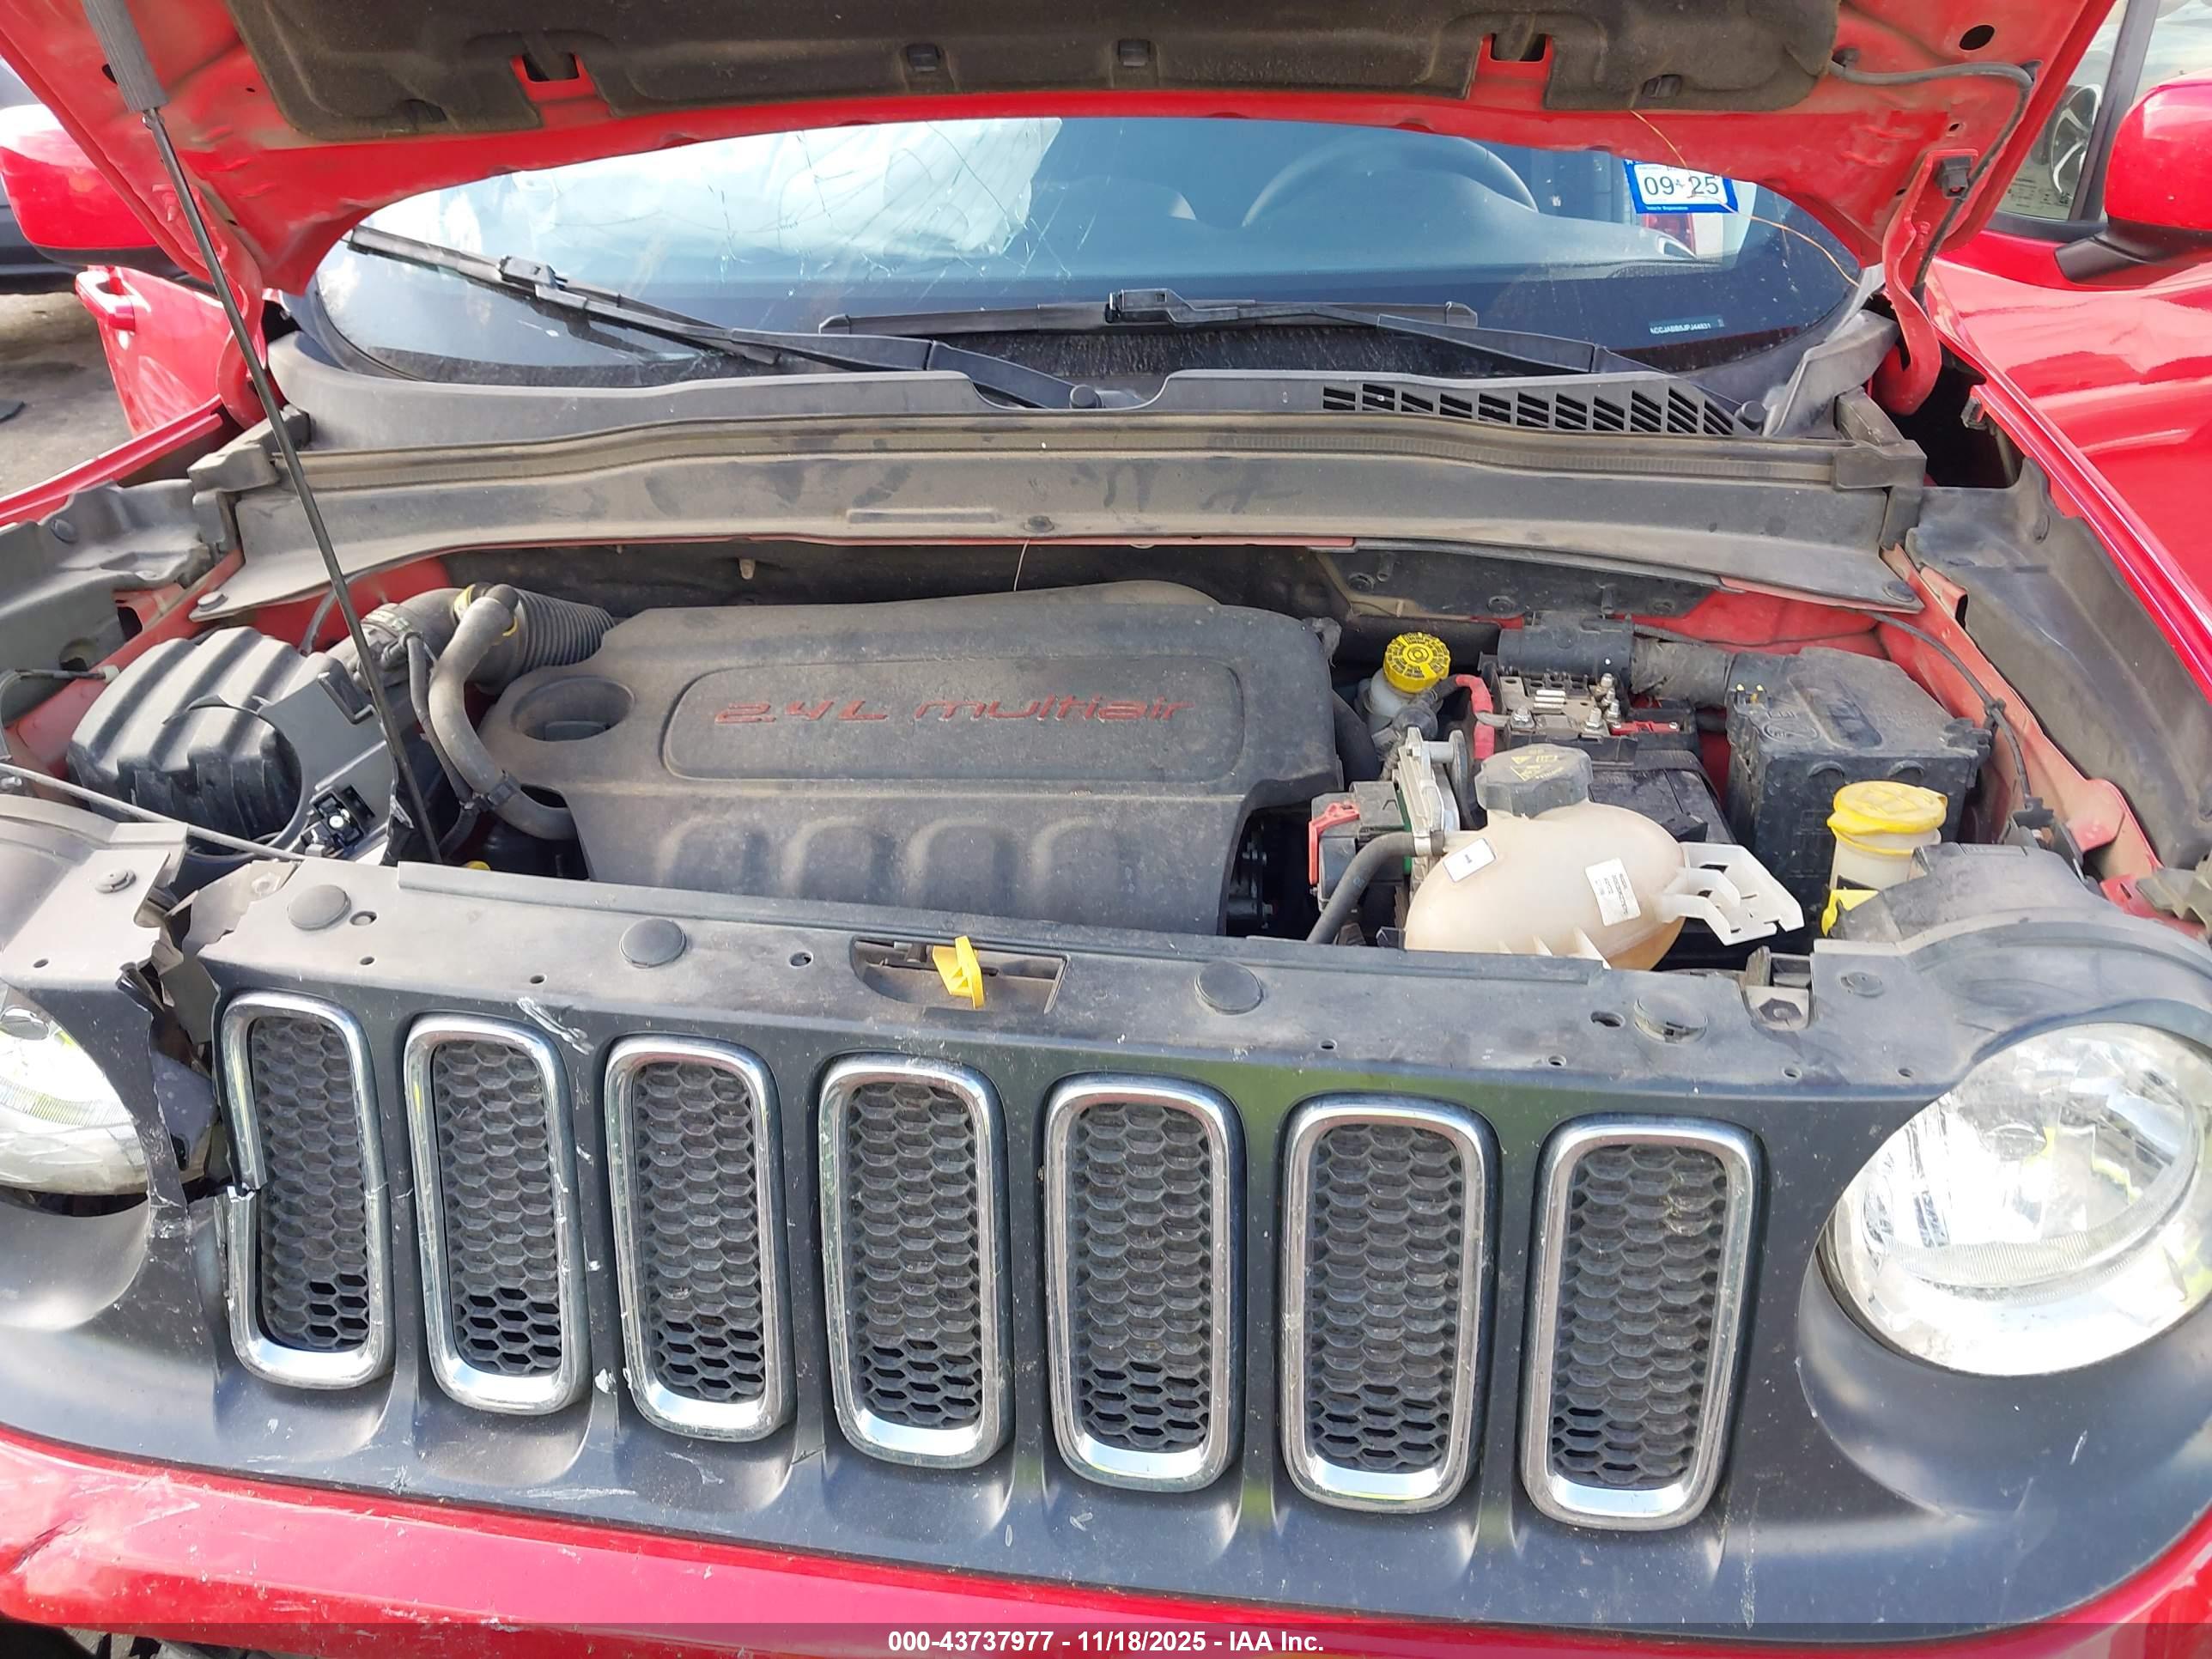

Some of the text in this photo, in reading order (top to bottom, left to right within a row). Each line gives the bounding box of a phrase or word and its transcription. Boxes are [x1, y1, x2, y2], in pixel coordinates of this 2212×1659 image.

[1644, 175, 1719, 196] 09 25
[914, 693, 1195, 722] multiair
